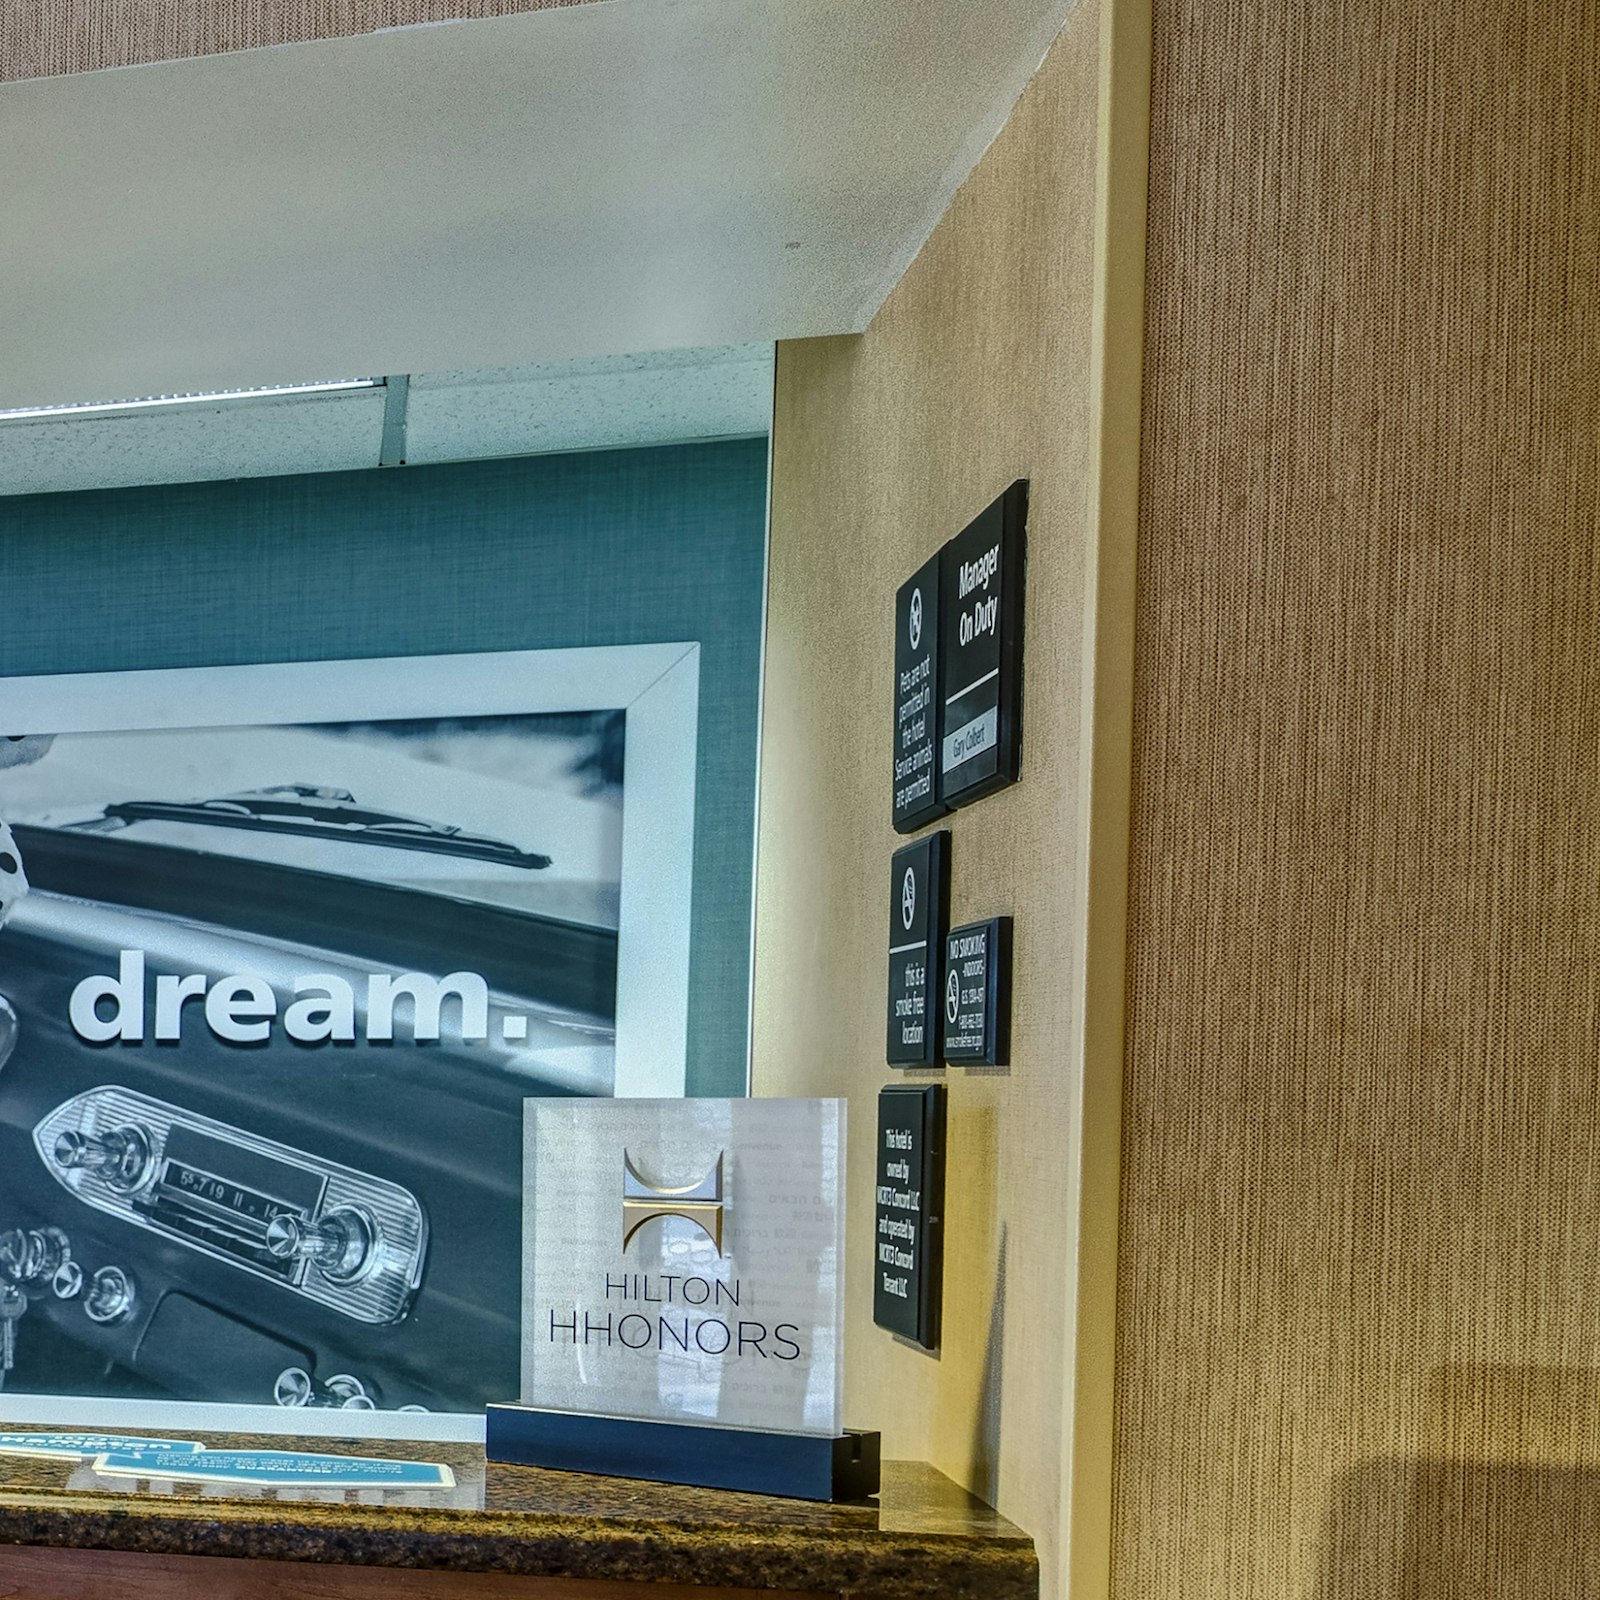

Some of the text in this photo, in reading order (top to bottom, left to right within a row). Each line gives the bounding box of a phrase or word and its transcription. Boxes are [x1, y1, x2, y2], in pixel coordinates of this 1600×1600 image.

[958, 543, 1000, 599] Manager
[959, 594, 998, 648] On Duty
[950, 934, 985, 960] NO SMOKING
[68, 948, 529, 1048] dream.
[895, 990, 924, 1017] smoke free
[902, 1020, 923, 1044] location
[605, 1272, 741, 1306] HILTON
[550, 1309, 801, 1361] HHONORS
